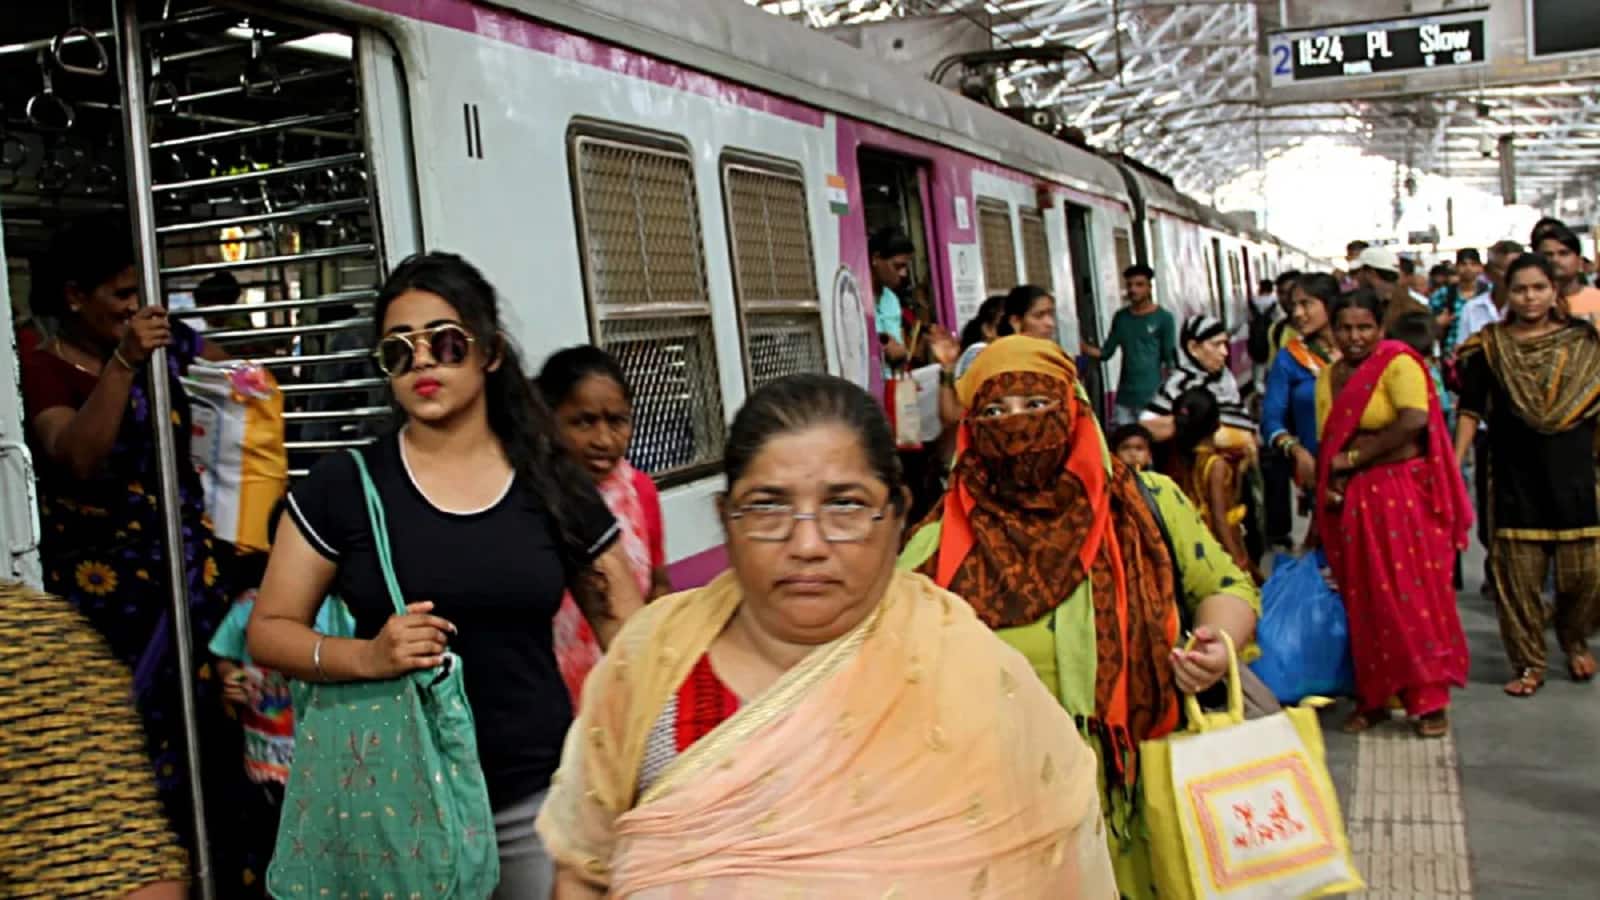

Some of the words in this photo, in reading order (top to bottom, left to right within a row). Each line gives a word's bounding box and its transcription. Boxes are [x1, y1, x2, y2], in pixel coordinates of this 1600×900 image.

[1366, 29, 1393, 58] PL
[1419, 23, 1470, 53] Slow
[1272, 44, 1291, 75] 2
